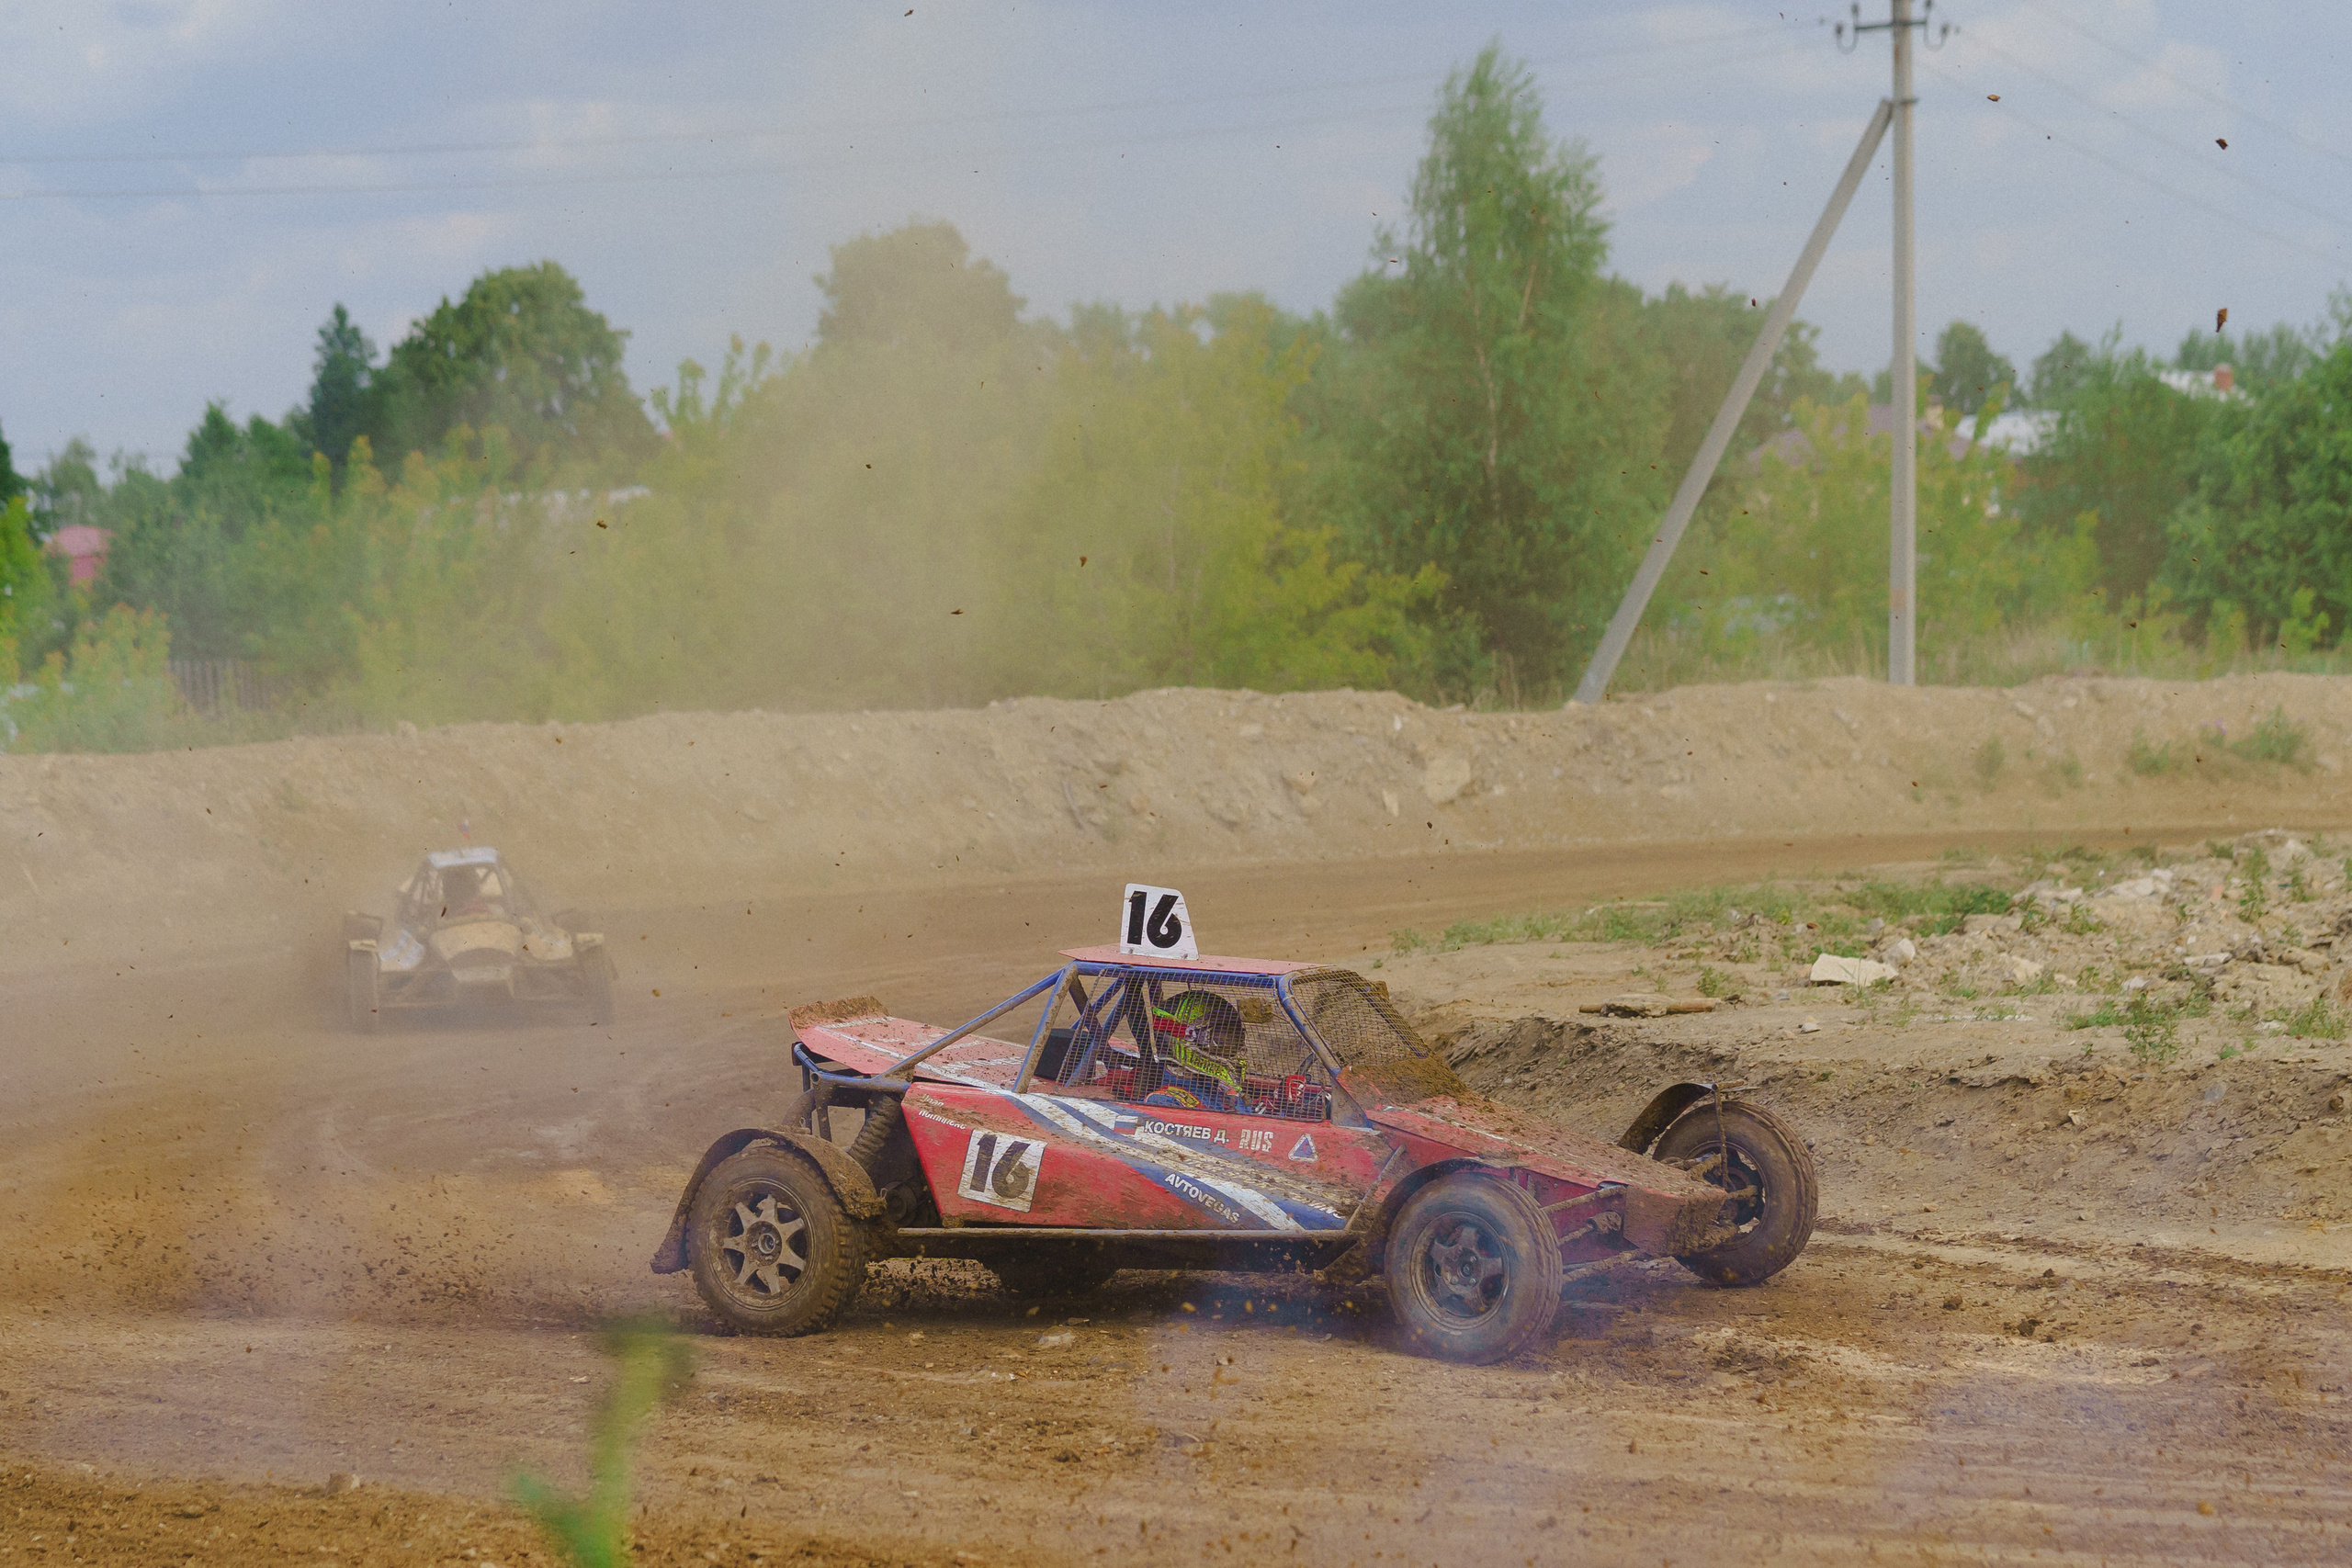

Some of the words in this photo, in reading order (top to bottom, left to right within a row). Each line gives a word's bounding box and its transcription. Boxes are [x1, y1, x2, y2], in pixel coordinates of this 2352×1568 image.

[1128, 890, 1182, 949] 16
[1144, 1121, 1212, 1140] КОСТЯЕВ
[1213, 1128, 1230, 1145] Д.
[1238, 1128, 1274, 1153] RUS
[969, 1134, 1031, 1200] 16
[1164, 1173, 1240, 1224] AVTOVEGAS
